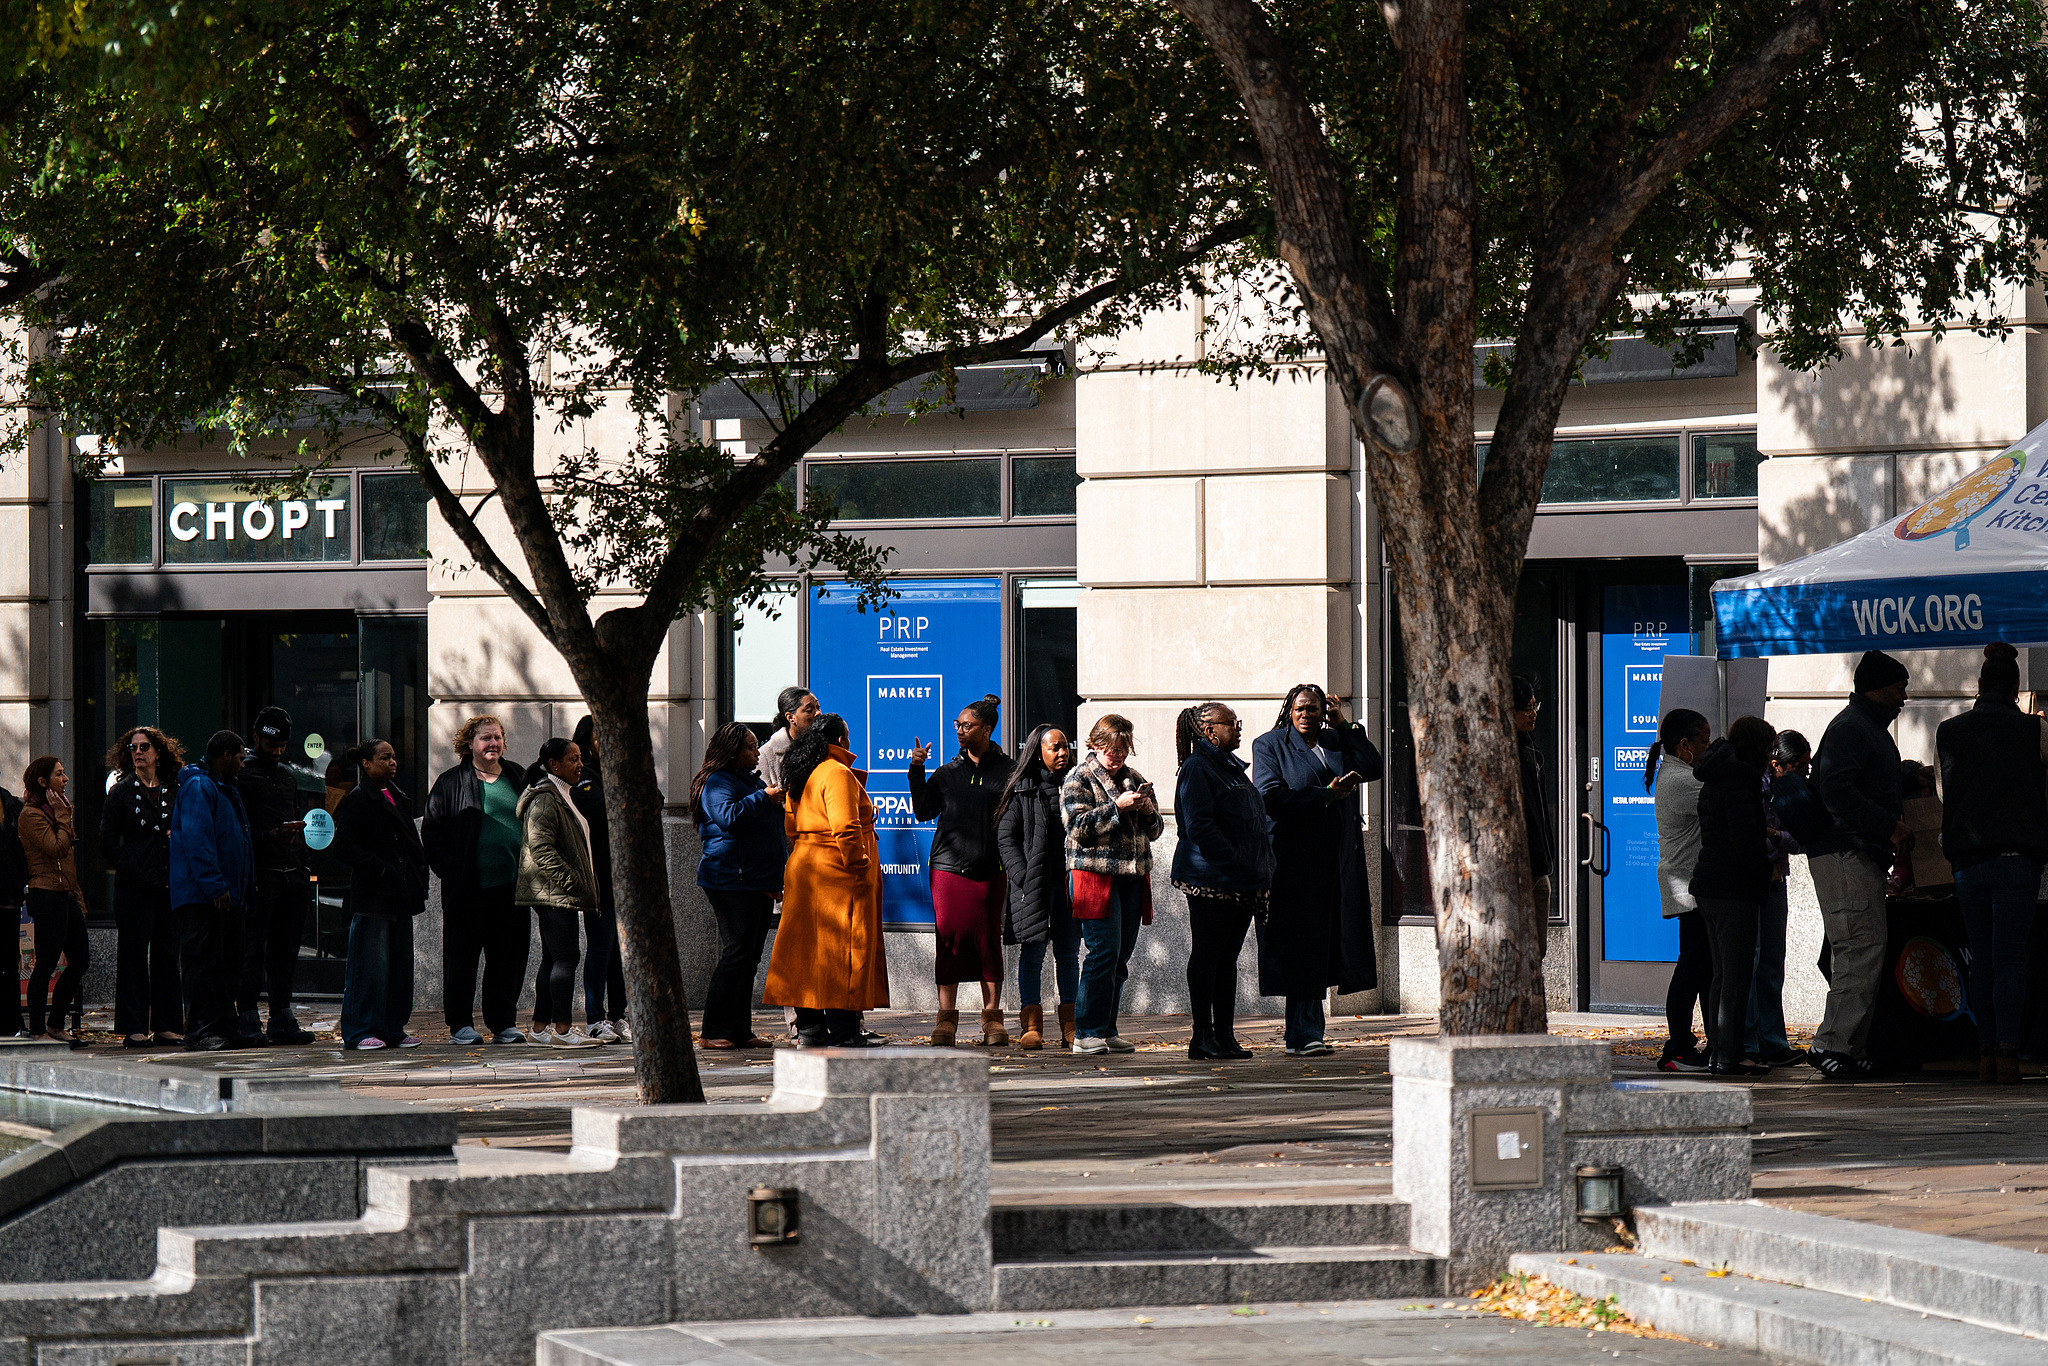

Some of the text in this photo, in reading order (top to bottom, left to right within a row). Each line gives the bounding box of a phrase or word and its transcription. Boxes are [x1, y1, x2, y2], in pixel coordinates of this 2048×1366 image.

[1706, 463, 1730, 492] XIT
[2013, 483, 2048, 506] Ce
[169, 500, 346, 541] CHOPT
[1852, 593, 1984, 636] WCK.ORG
[1632, 673, 1663, 681] MARKE
[878, 687, 932, 699] MARKET
[1632, 715, 1658, 724] SQUA
[878, 748, 932, 761] SQUAE
